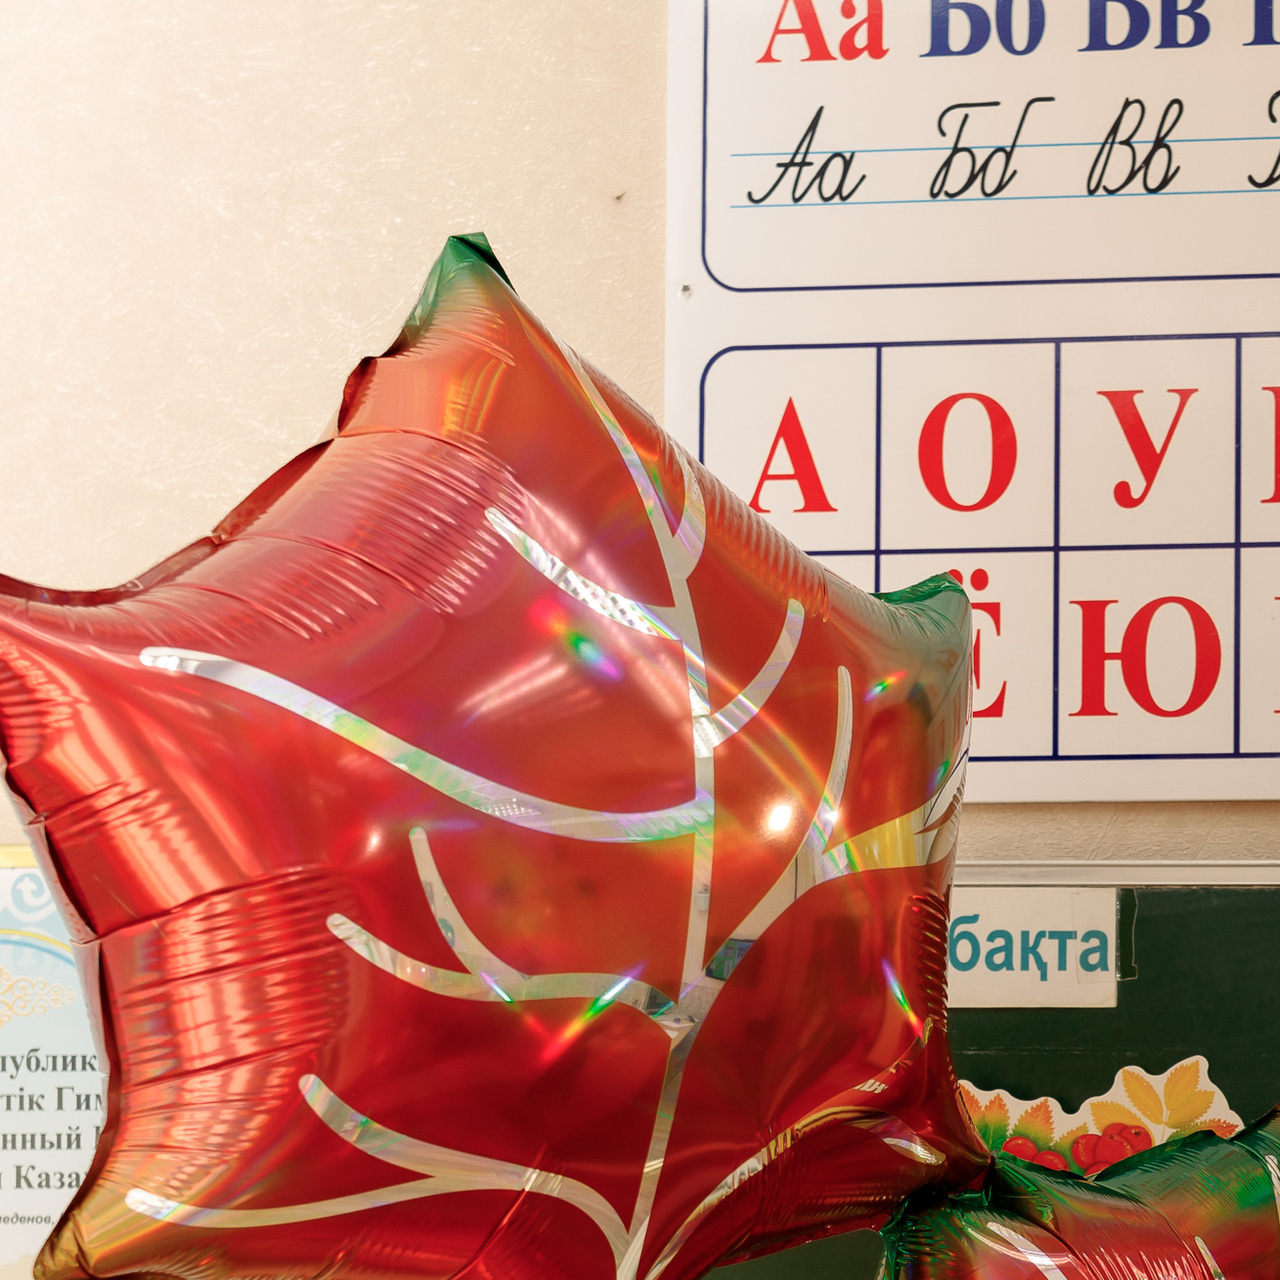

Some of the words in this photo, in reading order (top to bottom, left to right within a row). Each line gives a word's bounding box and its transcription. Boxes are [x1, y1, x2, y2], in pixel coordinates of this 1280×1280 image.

[748, 105, 866, 204] Аа
[929, 96, 1055, 199] Бб
[1086, 97, 1181, 196] Вв
[749, 396, 838, 513] А
[917, 392, 1019, 513] О
[1096, 387, 1200, 509] У
[1067, 596, 1223, 718] Ю
[949, 913, 1111, 982] бақта
[1, 1125, 82, 1151] нный
[14, 1164, 88, 1190] Каза
